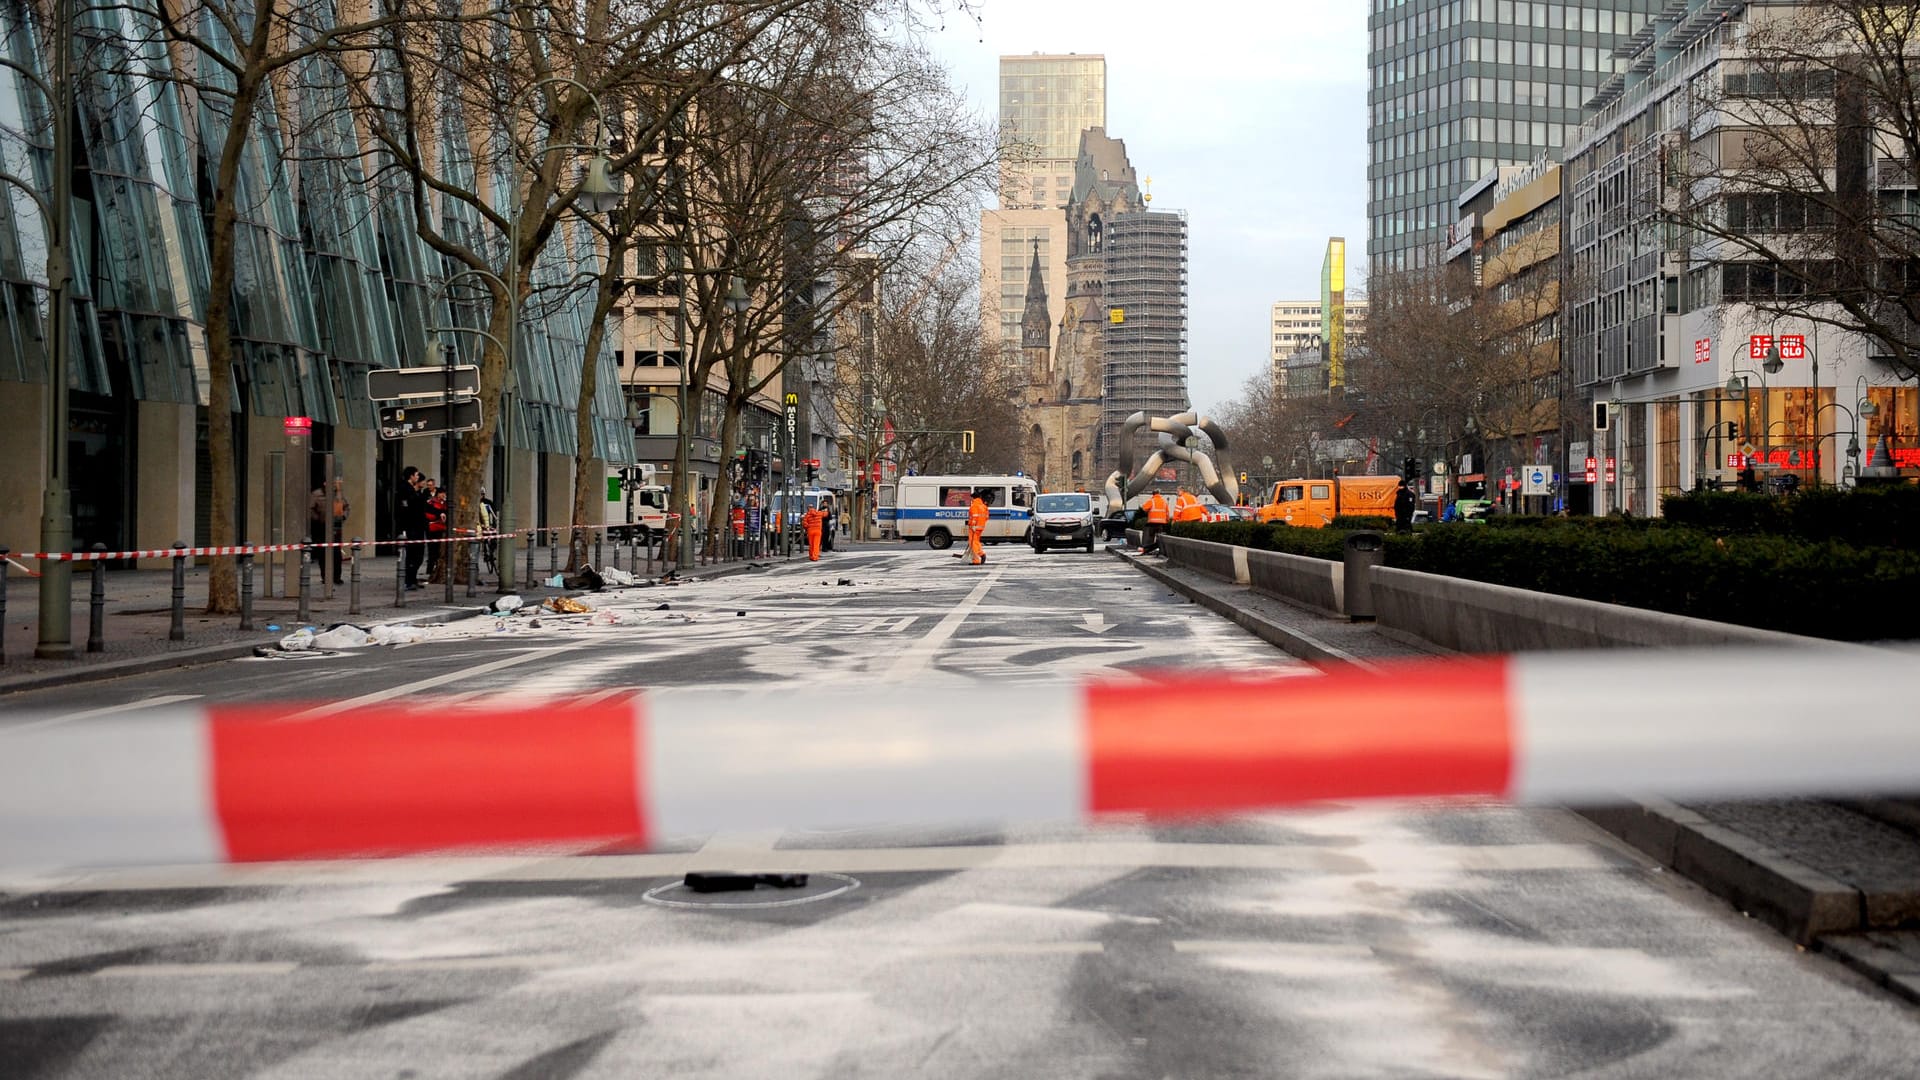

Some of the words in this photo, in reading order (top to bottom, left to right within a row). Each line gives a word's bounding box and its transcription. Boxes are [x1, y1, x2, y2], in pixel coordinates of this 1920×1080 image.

[1474, 255, 1483, 286] SATURN
[1782, 347, 1802, 357] QLO
[1359, 491, 1382, 500] BSR
